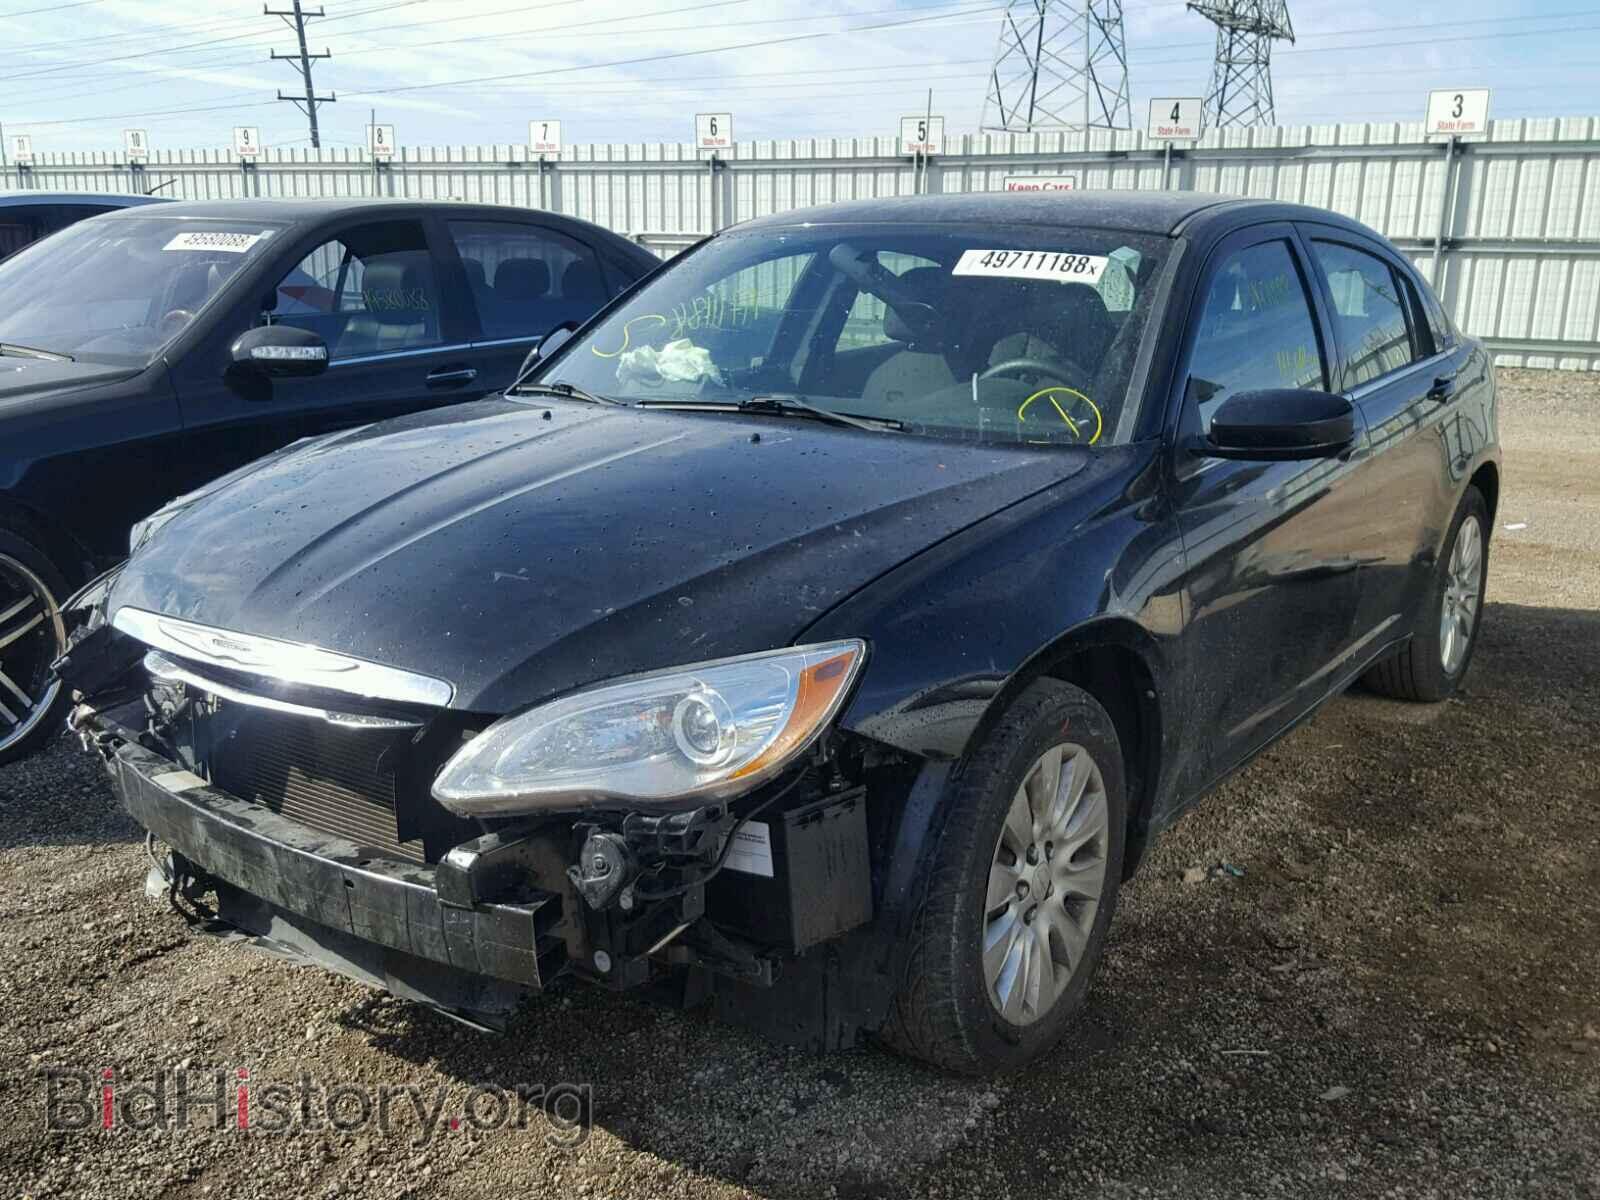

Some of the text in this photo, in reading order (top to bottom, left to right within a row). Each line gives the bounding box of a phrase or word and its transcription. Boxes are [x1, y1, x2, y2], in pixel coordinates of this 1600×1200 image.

[1170, 102, 1180, 124] 4
[1452, 94, 1463, 118] 3
[542, 123, 548, 140] 7
[710, 117, 717, 136] 6
[918, 121, 926, 141] 5
[131, 133, 140, 147] 10
[243, 129, 249, 144] 9
[376, 128, 383, 144] 8
